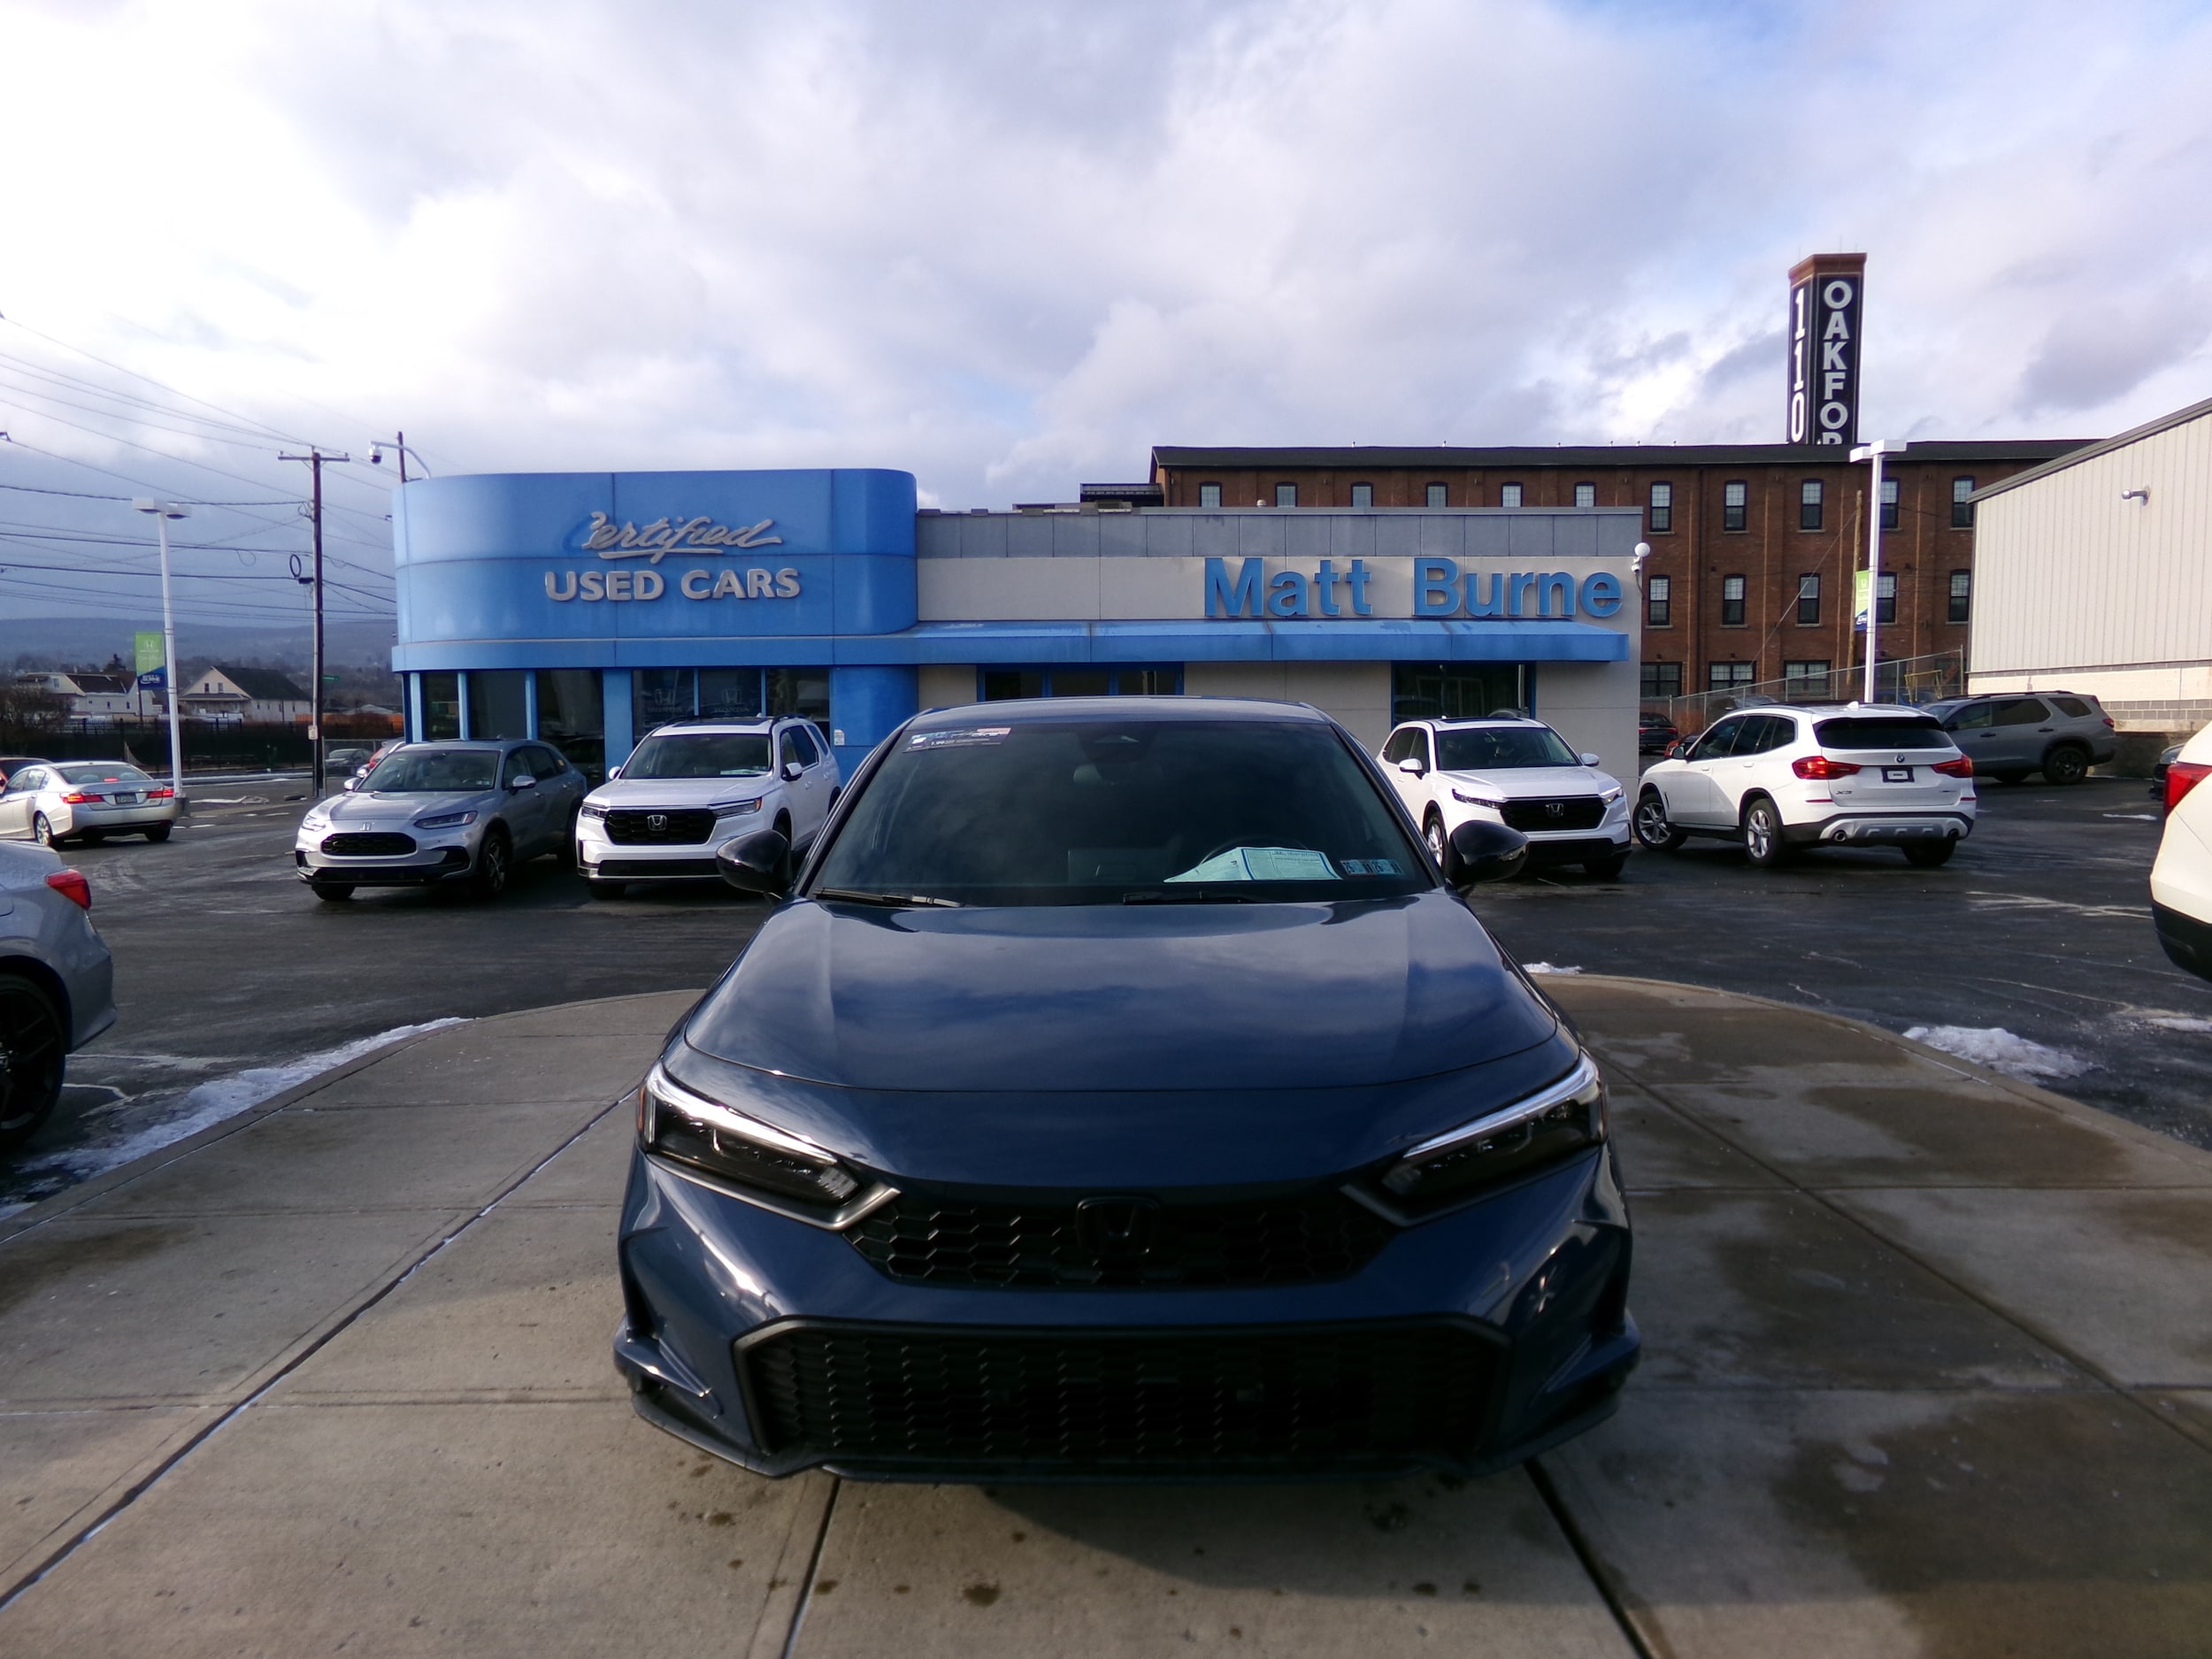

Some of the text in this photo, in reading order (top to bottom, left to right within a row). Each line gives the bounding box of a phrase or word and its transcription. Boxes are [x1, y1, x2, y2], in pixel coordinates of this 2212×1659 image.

[545, 568, 801, 602] USED CARS
[1203, 557, 1624, 618] Matt Burne
